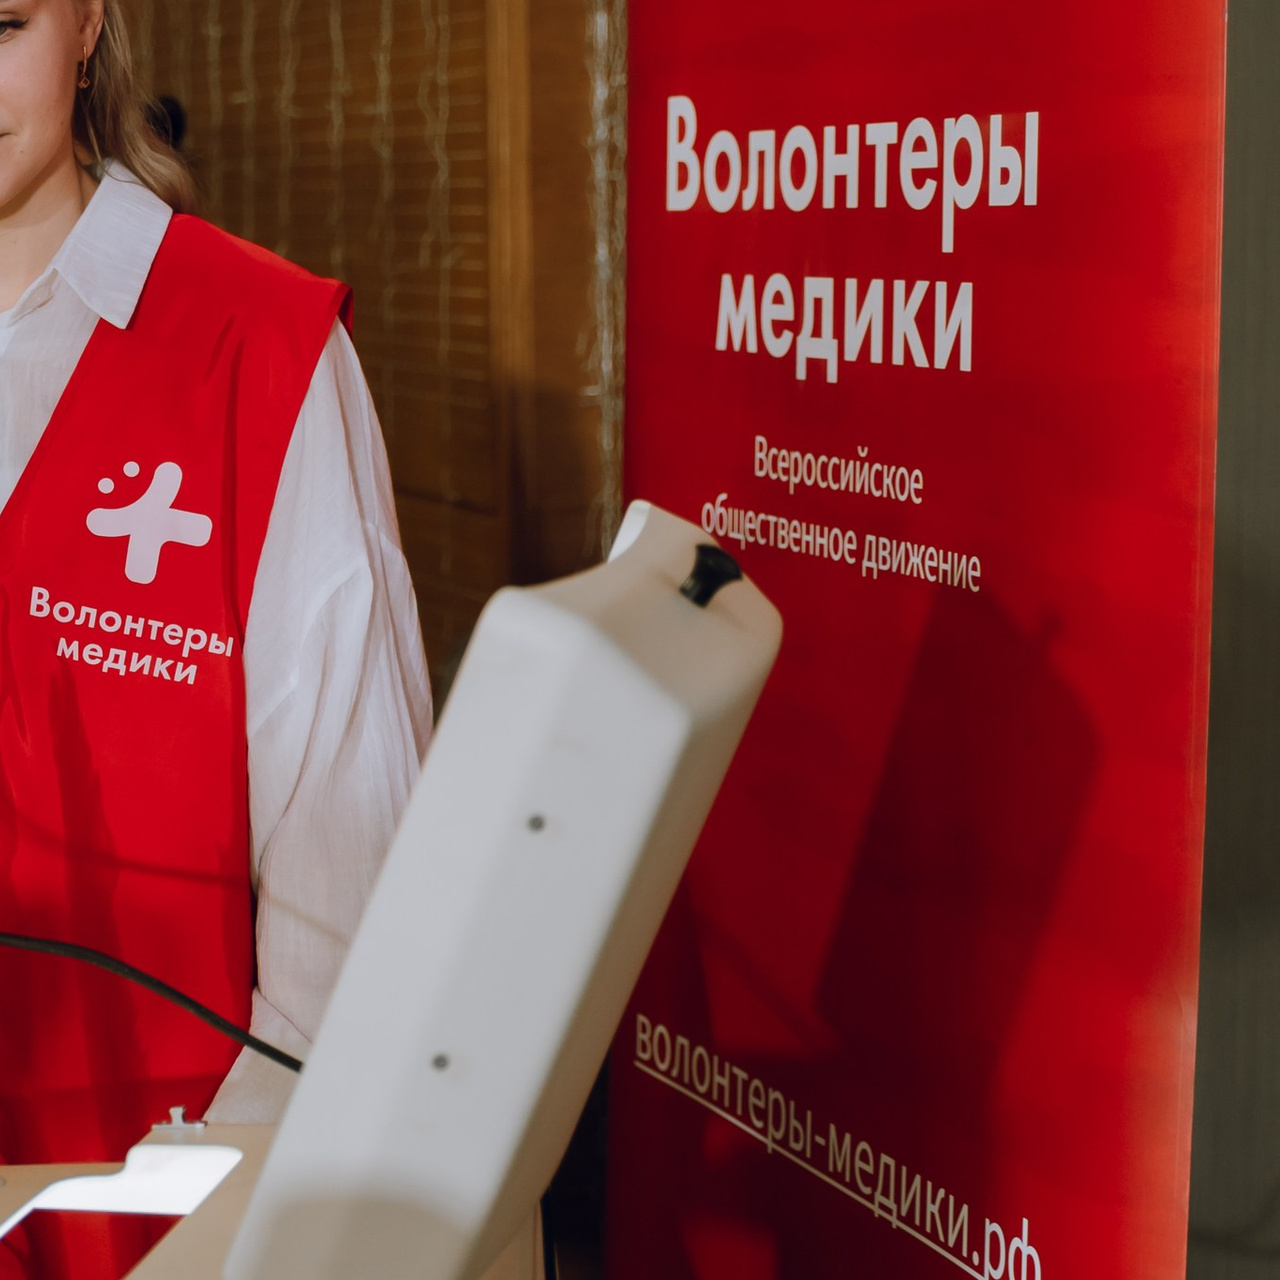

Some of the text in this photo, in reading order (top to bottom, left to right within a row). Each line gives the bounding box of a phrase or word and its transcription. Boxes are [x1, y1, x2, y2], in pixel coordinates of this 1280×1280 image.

[666, 95, 1039, 253] Волонтеры
[715, 273, 974, 384] медики
[754, 435, 924, 504] Всероссийское
[701, 493, 982, 593] общественное движение
[29, 586, 234, 658] Волонтеры
[56, 637, 198, 685] медики
